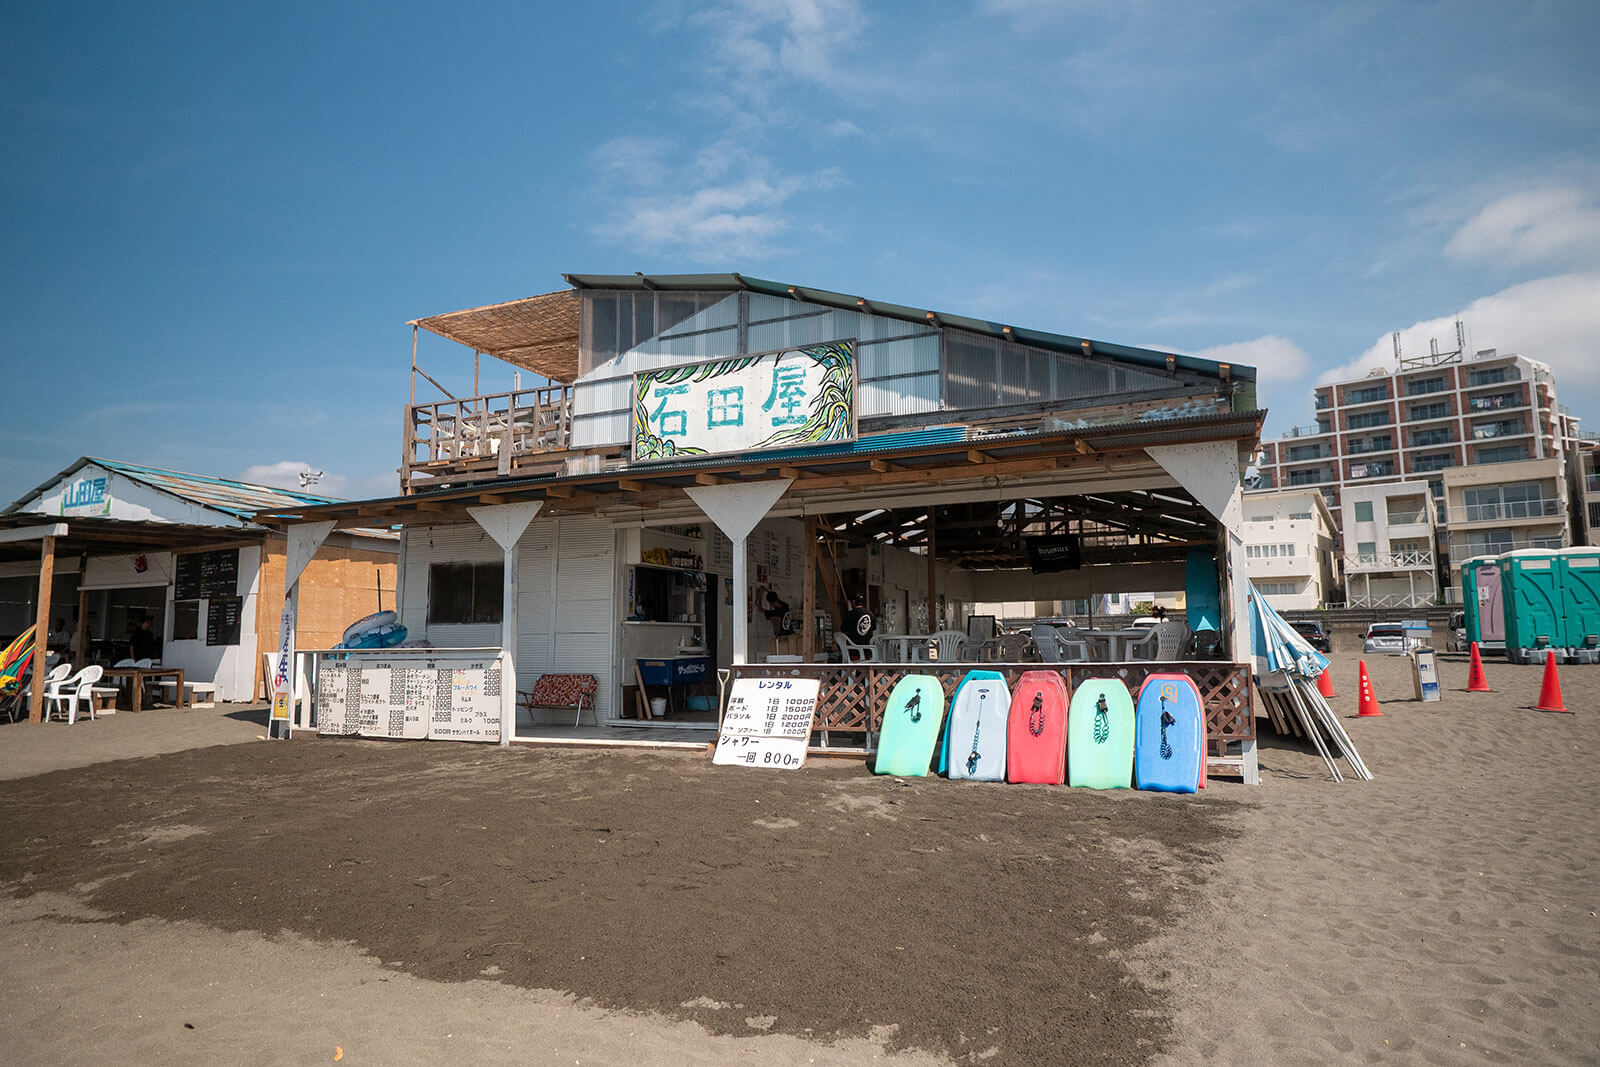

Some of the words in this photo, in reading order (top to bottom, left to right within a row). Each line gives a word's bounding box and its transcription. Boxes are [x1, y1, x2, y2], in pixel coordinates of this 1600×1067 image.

[649, 364, 808, 438] 石田屋
[63, 477, 107, 509] 山田屋
[758, 680, 793, 690] レンタル
[728, 704, 748, 712] ボード
[766, 705, 779, 713] 1日
[784, 705, 814, 713] 1500円
[766, 713, 777, 721] 1日
[781, 713, 812, 721] 2000円
[781, 720, 810, 728] 1200円
[721, 735, 760, 747] シャワー
[736, 751, 757, 763] 一回
[763, 751, 800, 766] 800円
